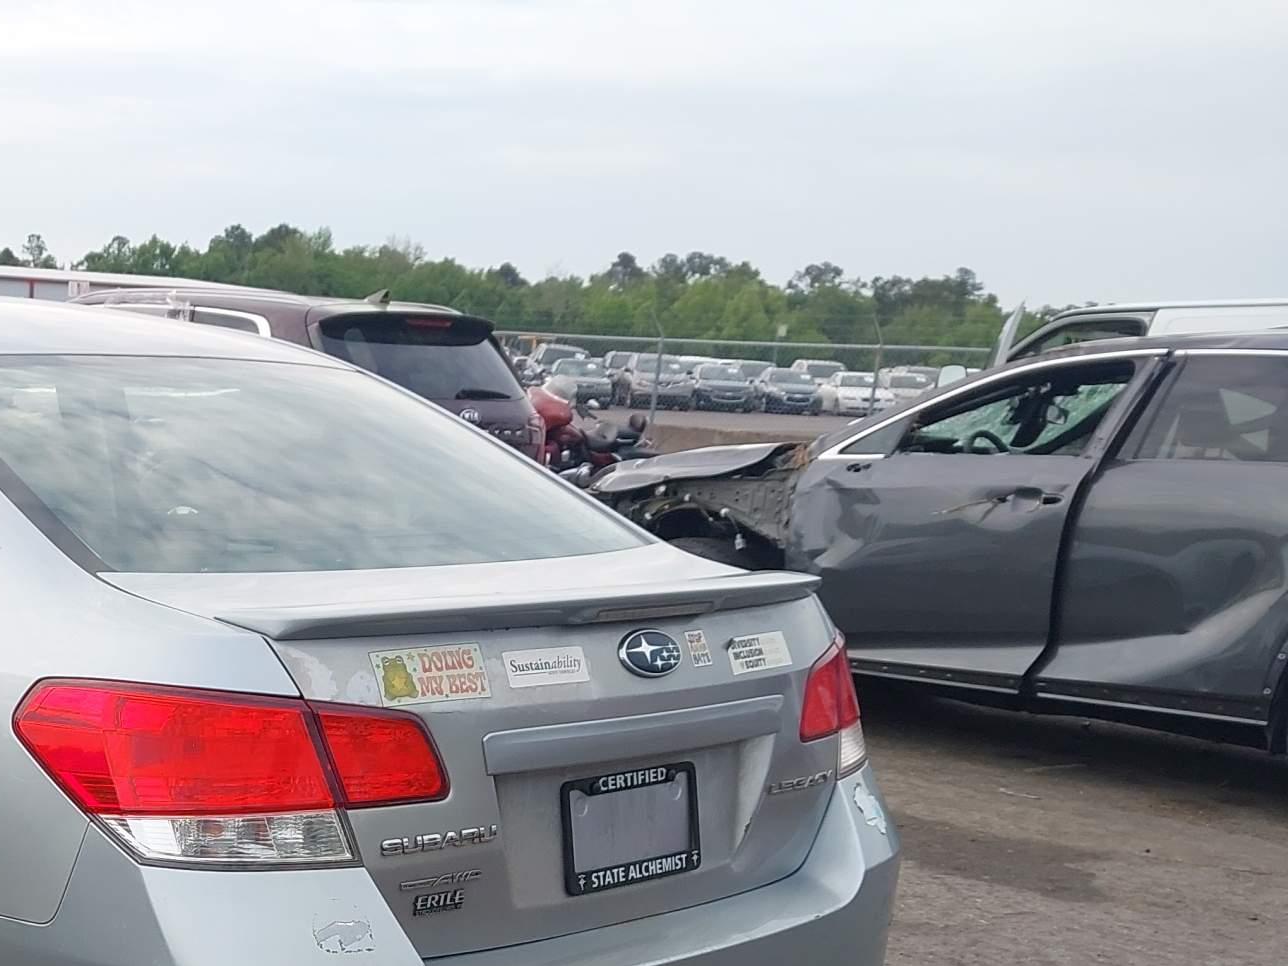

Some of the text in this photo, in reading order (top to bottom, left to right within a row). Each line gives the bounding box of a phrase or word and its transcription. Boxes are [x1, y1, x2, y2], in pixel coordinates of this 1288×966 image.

[417, 648, 474, 673] DOING
[509, 655, 581, 674] Sustainability
[732, 648, 764, 660] INCLUSION
[745, 658, 767, 669] EQUITY
[419, 671, 487, 698] MY BEST
[599, 768, 666, 791] CERTIFIED
[381, 824, 497, 856] SUBARU
[591, 854, 688, 888] STATE ALCHEMIST
[415, 889, 465, 910] ERTLE
